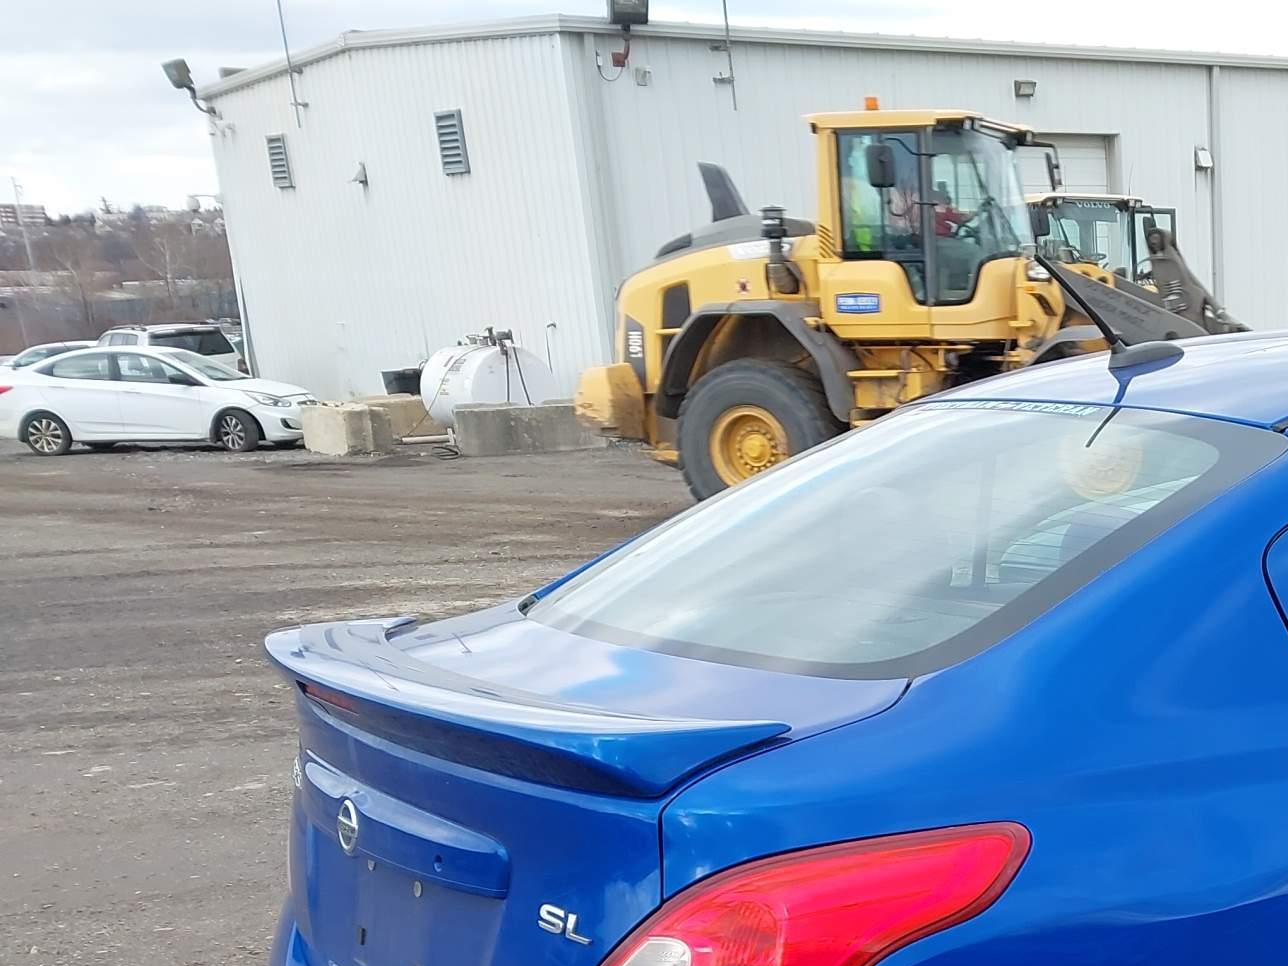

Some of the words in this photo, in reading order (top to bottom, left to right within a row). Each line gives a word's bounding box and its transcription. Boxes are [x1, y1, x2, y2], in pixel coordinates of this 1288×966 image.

[1076, 201, 1110, 209] VOLVO
[628, 331, 643, 358] L90H
[1013, 402, 1102, 417] VETERAN
[538, 903, 593, 945] SL
